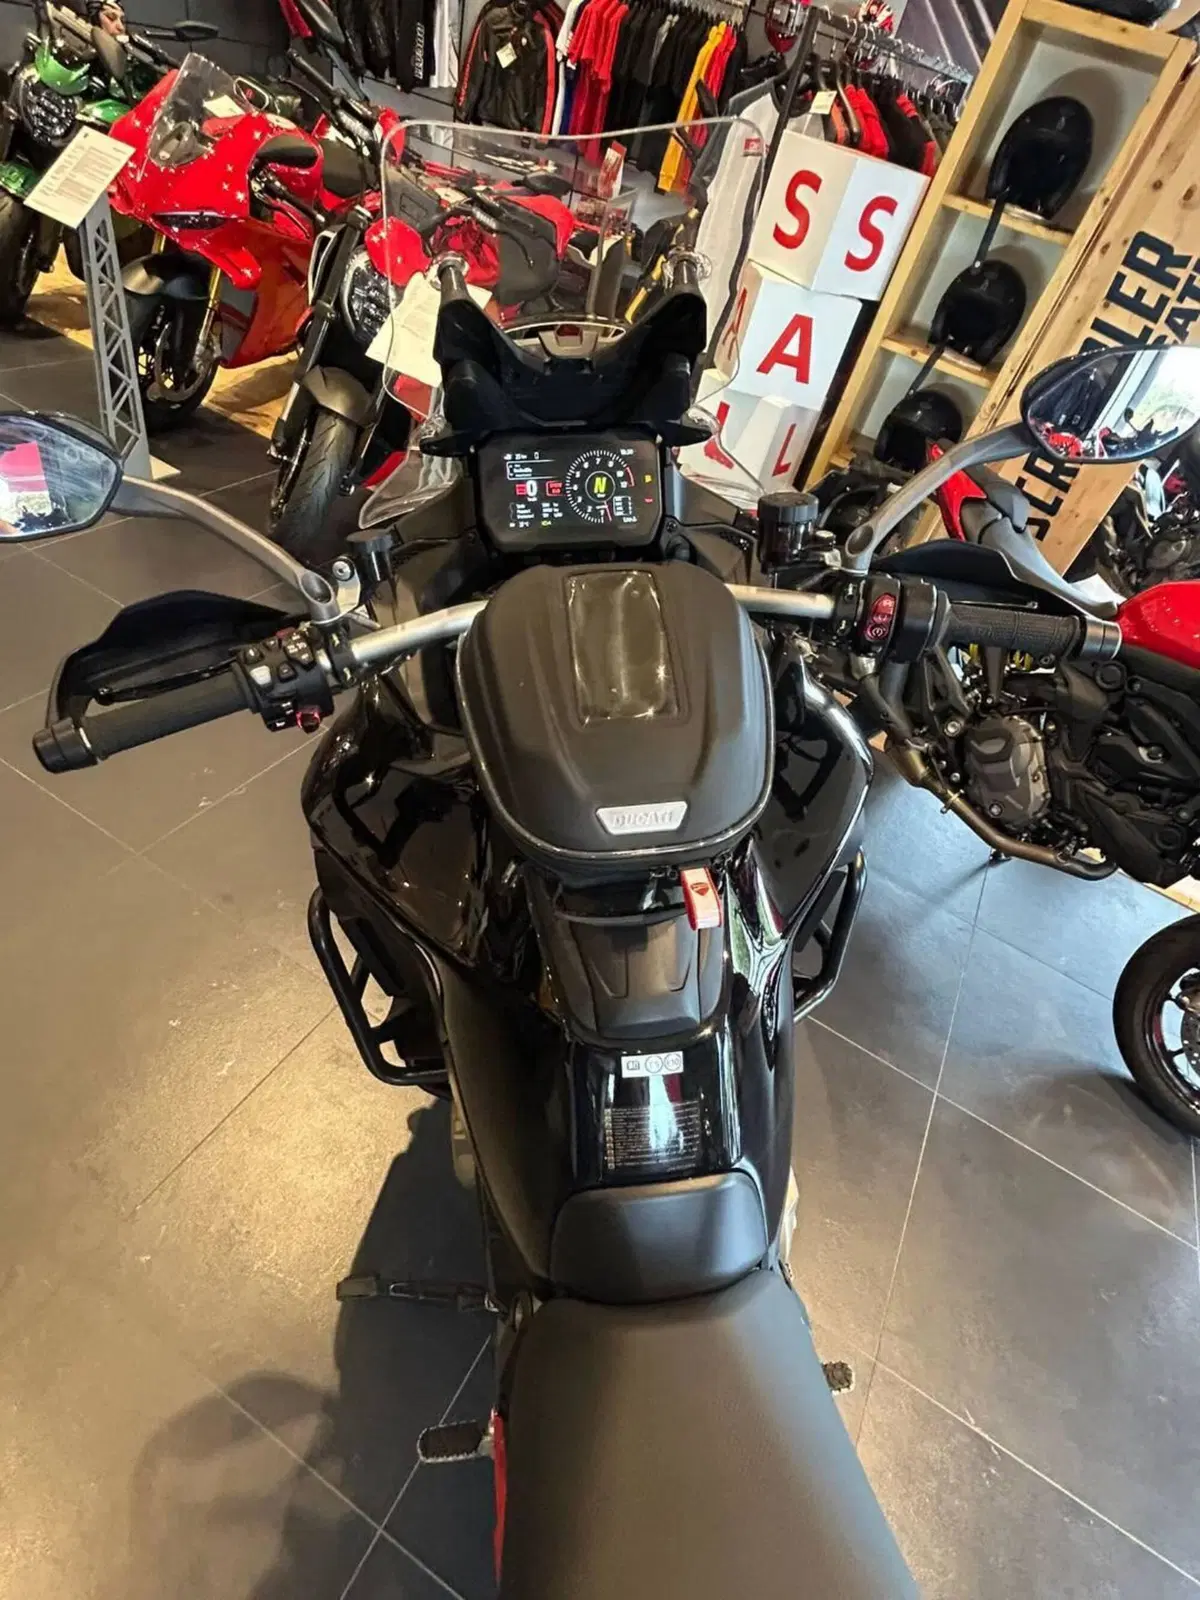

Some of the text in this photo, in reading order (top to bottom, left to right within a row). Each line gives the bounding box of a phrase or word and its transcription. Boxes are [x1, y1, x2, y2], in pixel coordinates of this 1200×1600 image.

[773, 170, 823, 249] S
[844, 196, 898, 272] S
[756, 313, 814, 385] A
[526, 480, 538, 497] 0
[594, 477, 607, 493] N
[612, 811, 674, 828] DUCATI
